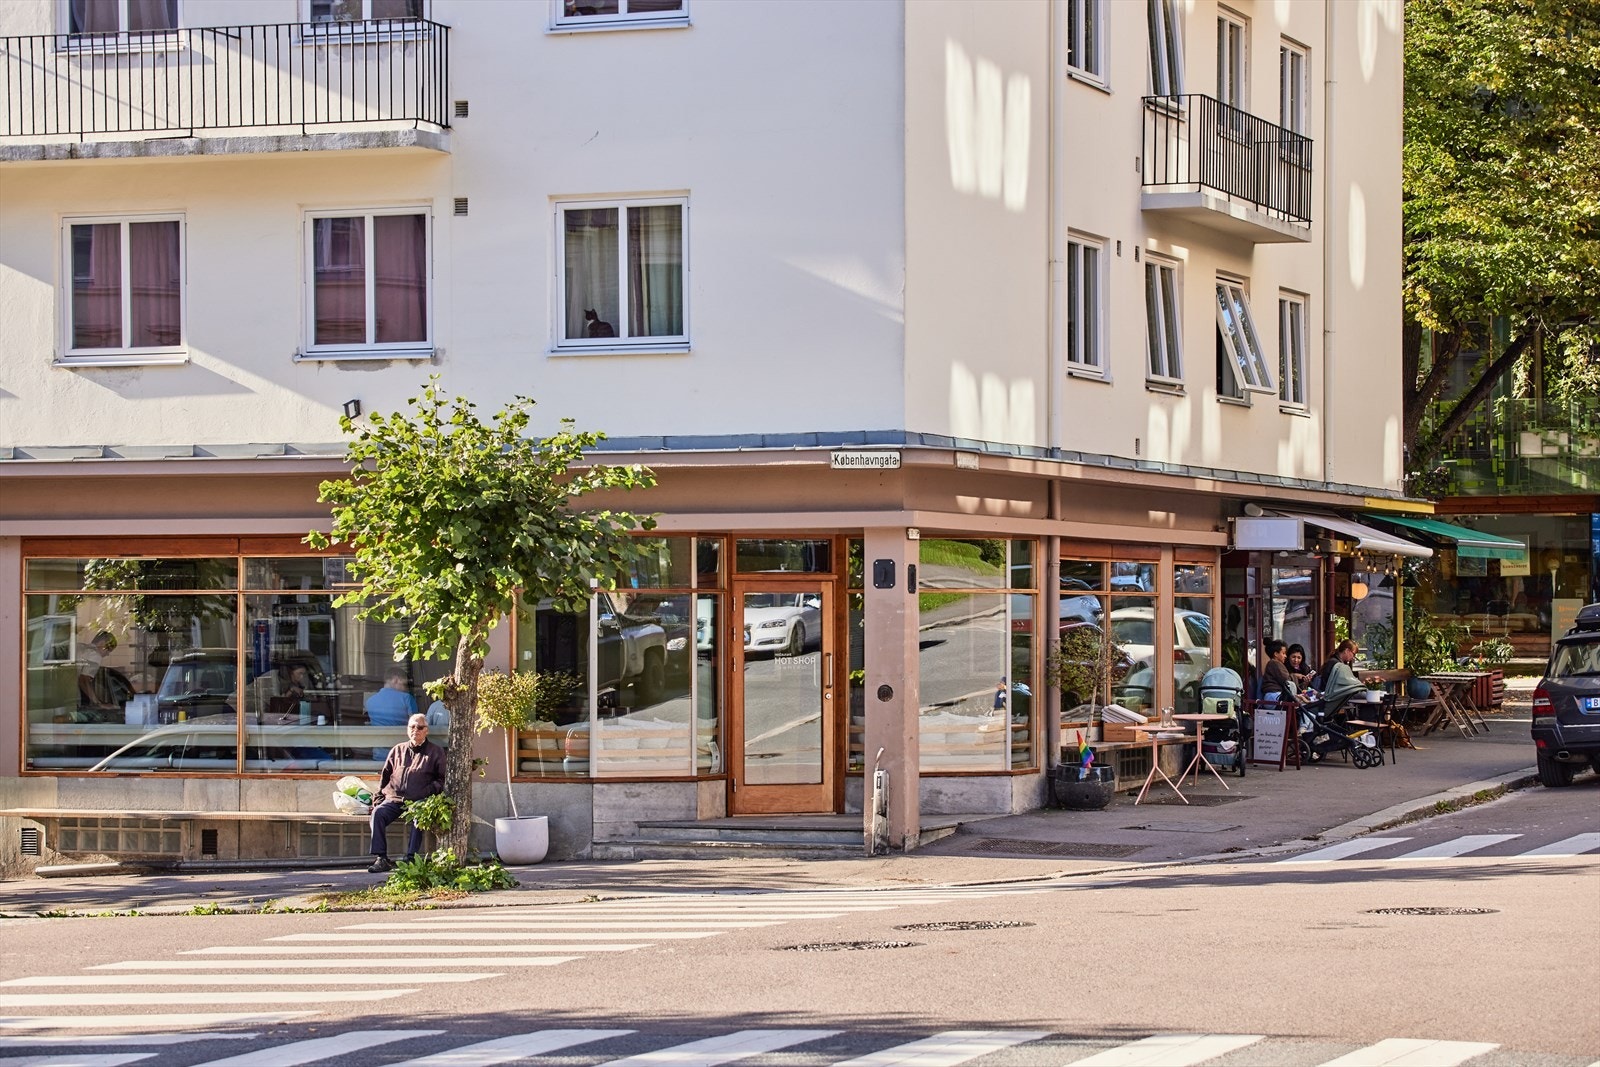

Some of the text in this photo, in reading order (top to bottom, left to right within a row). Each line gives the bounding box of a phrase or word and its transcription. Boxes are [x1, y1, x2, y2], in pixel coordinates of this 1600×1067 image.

[834, 454, 897, 467] Københavngata
[774, 656, 815, 665] HOT SHOP
